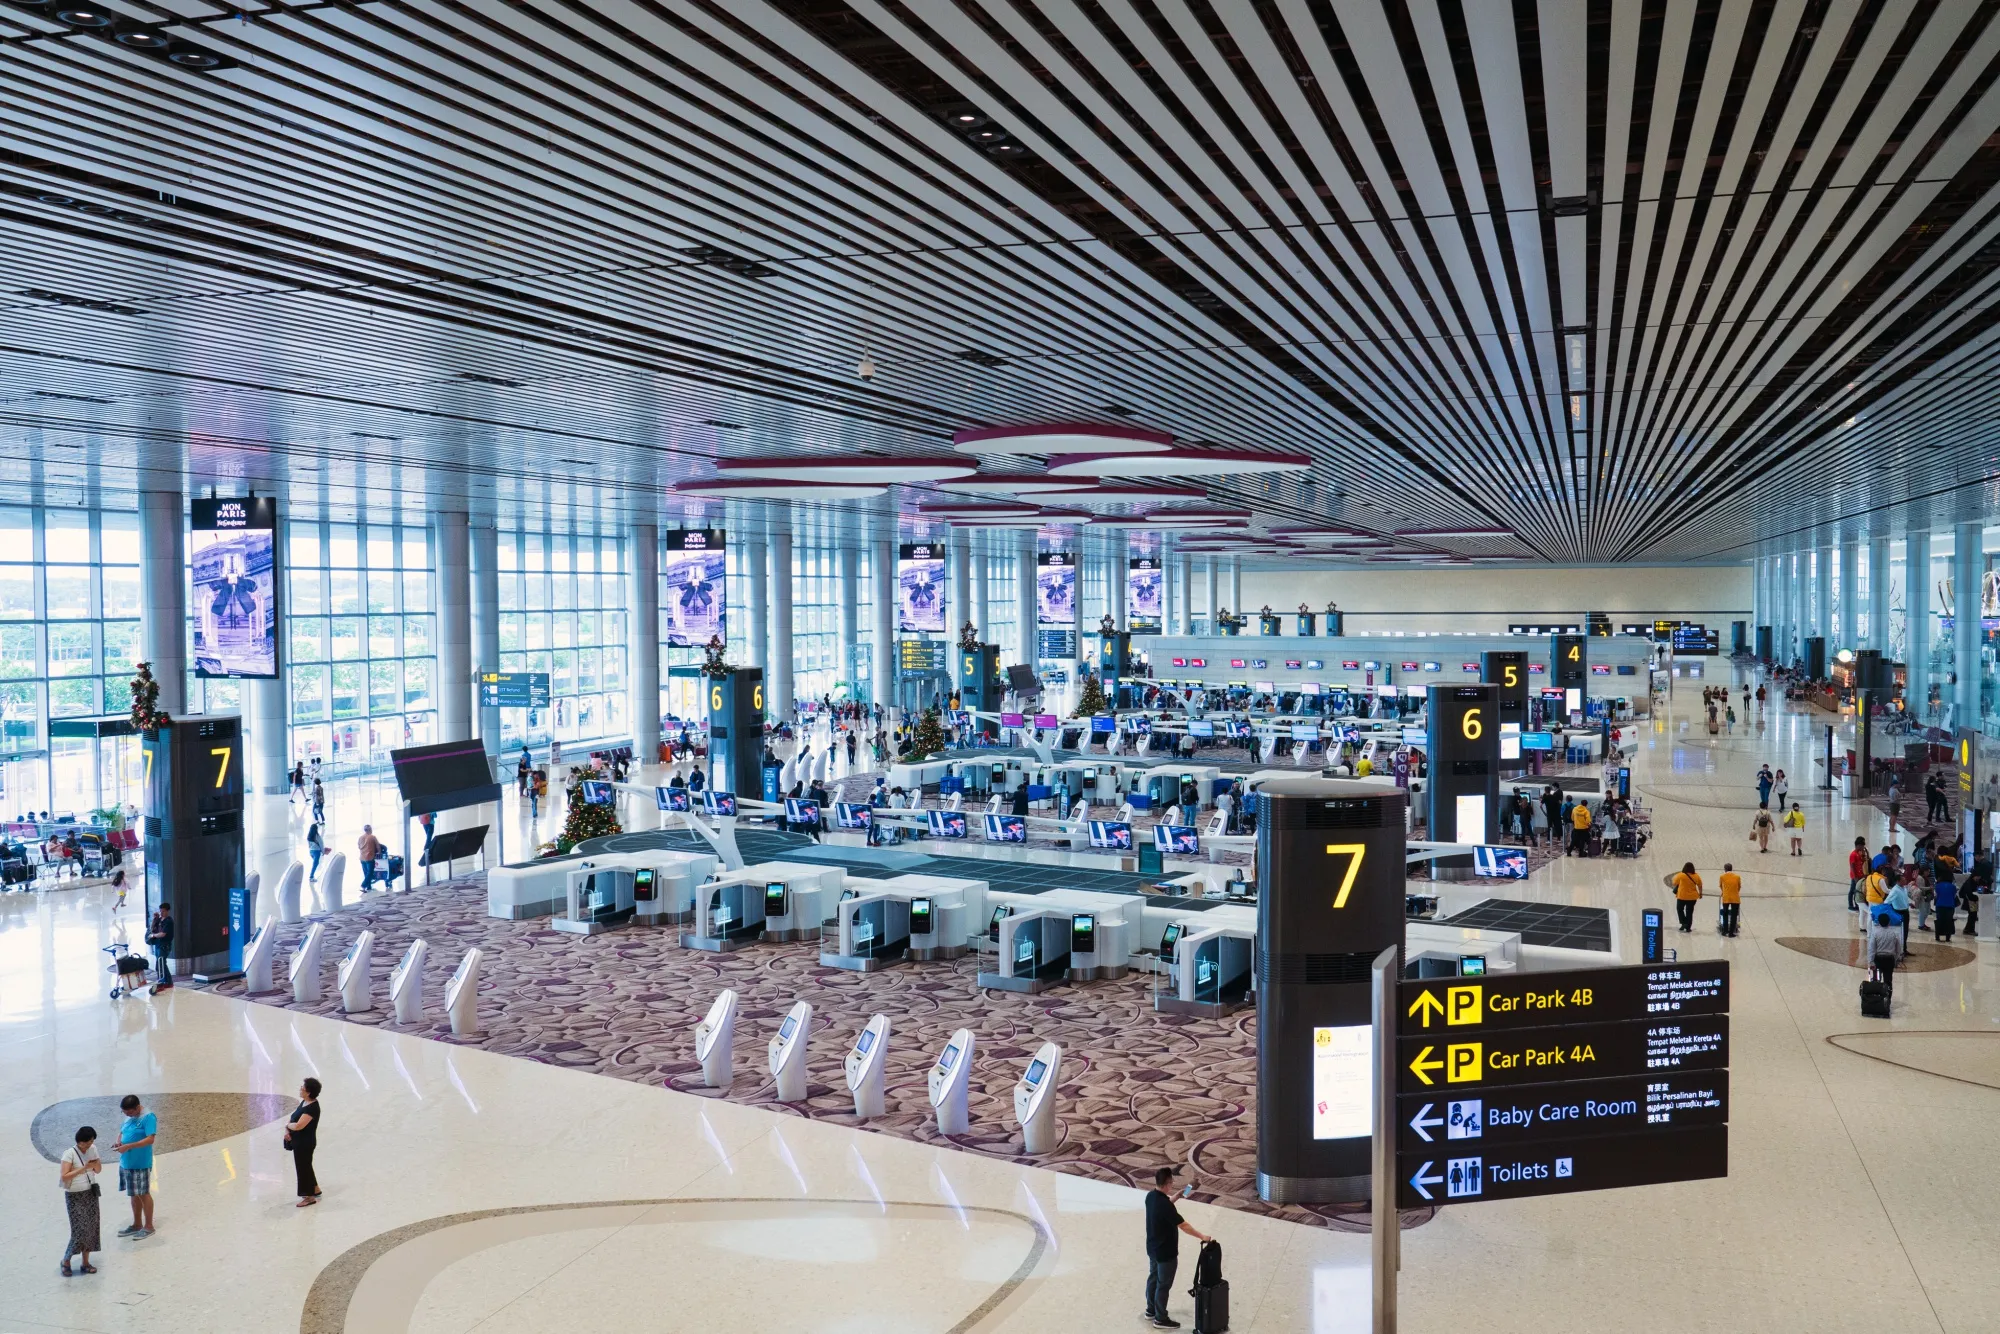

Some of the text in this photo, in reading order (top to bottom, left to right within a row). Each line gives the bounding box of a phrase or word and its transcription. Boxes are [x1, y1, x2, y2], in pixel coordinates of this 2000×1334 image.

[216, 510, 246, 518] PARIS
[222, 503, 241, 511] MON
[1263, 623, 1270, 634] 2
[1104, 642, 1112, 656] 4
[1568, 645, 1580, 662] 4
[965, 657, 974, 676] 5
[1504, 666, 1517, 687] 5
[711, 686, 722, 710] 6
[754, 685, 763, 710] 6
[1462, 708, 1482, 740] 6
[143, 750, 153, 788] 7
[211, 747, 231, 788] 7
[1326, 844, 1365, 908] 7
[1647, 929, 1656, 959] Trolleys
[1647, 973, 1658, 981] 4B
[1647, 979, 1722, 992] Tempat Meletak Kereta 4B
[1454, 991, 1475, 1020] P
[1489, 988, 1593, 1012] Car Park 4B
[1671, 1002, 1681, 1010] 4B
[1647, 1028, 1657, 1036] 4A
[1647, 1038, 1669, 1048] Tempat
[1669, 1036, 1693, 1045] Meletak
[1713, 1033, 1722, 1041] 4A
[1454, 1048, 1475, 1078] P
[1489, 1045, 1596, 1069] Car Park 4A
[1671, 1057, 1681, 1065] 4A
[1646, 1089, 1713, 1102] Bilik Persalinan Bayi
[1489, 1100, 1637, 1127] Baby Care Room
[1489, 1162, 1549, 1183] Toilets
